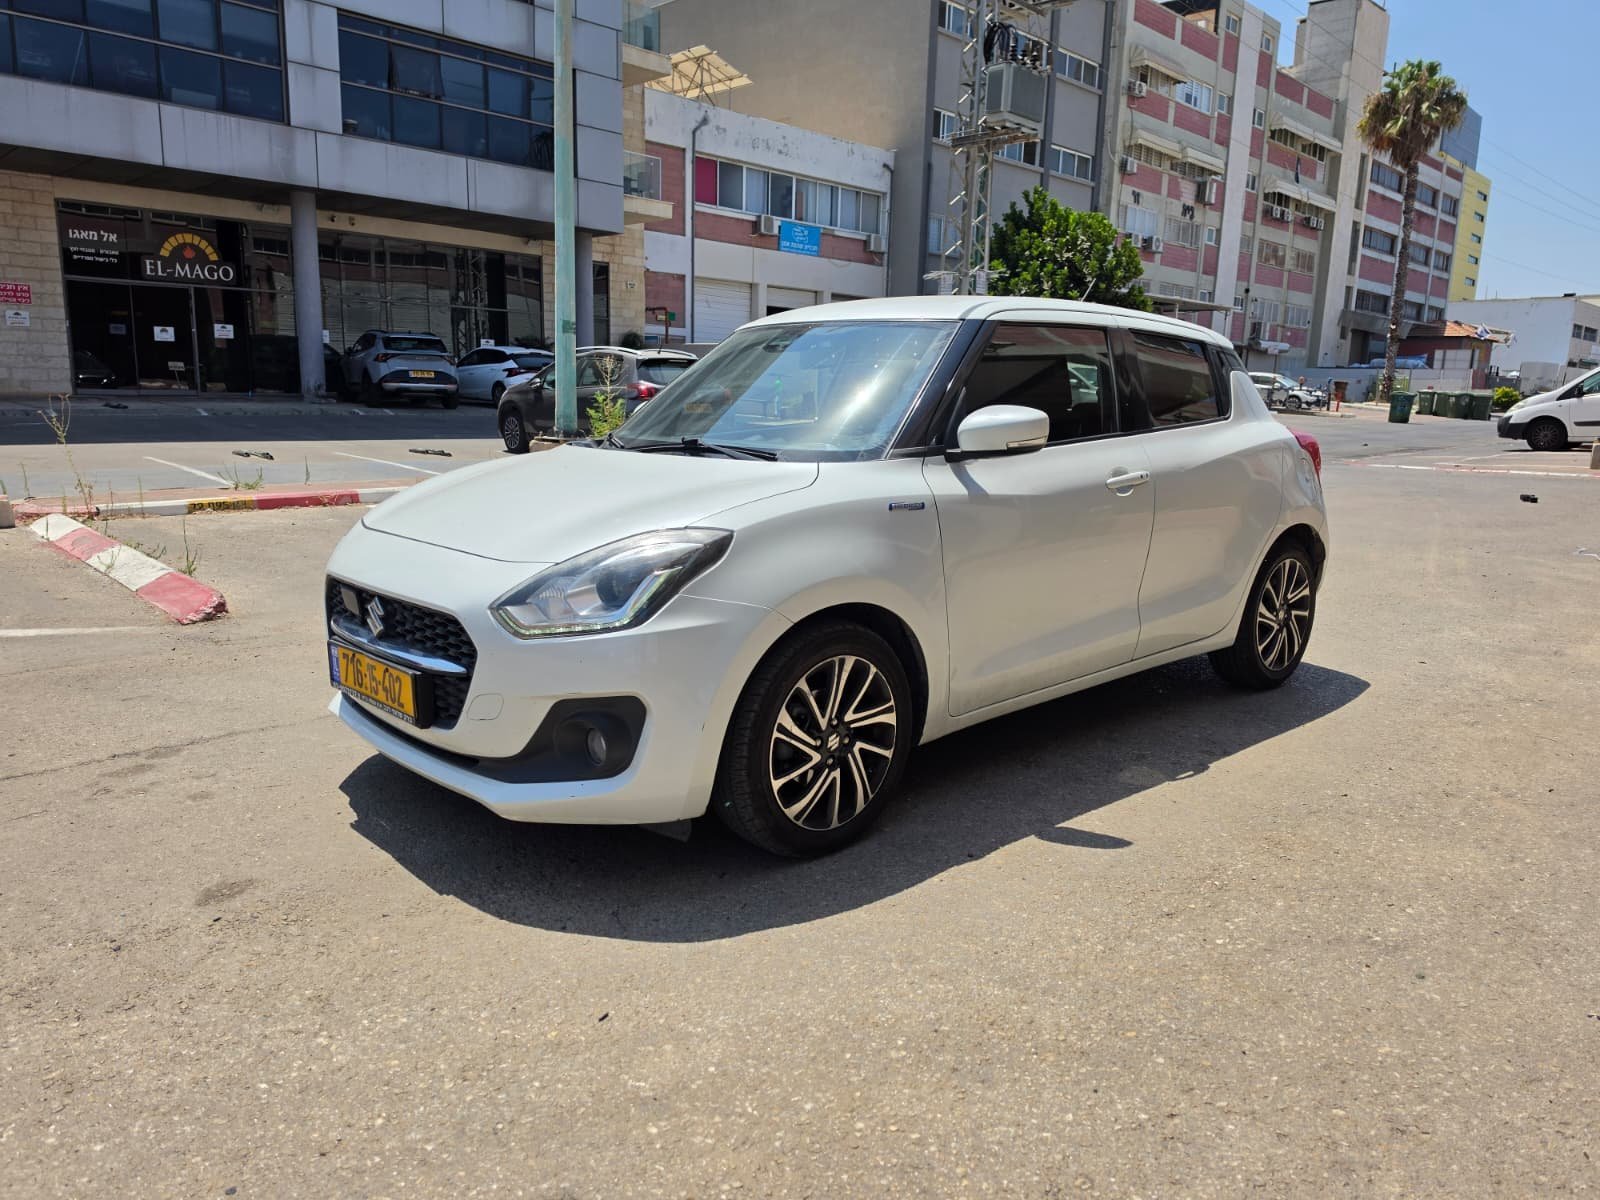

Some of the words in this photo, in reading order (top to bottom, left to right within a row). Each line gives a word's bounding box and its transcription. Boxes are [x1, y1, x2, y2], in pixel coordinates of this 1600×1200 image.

[69, 229, 98, 241] מאגו
[100, 230, 117, 242] אל
[144, 260, 234, 281] EL-MAGO
